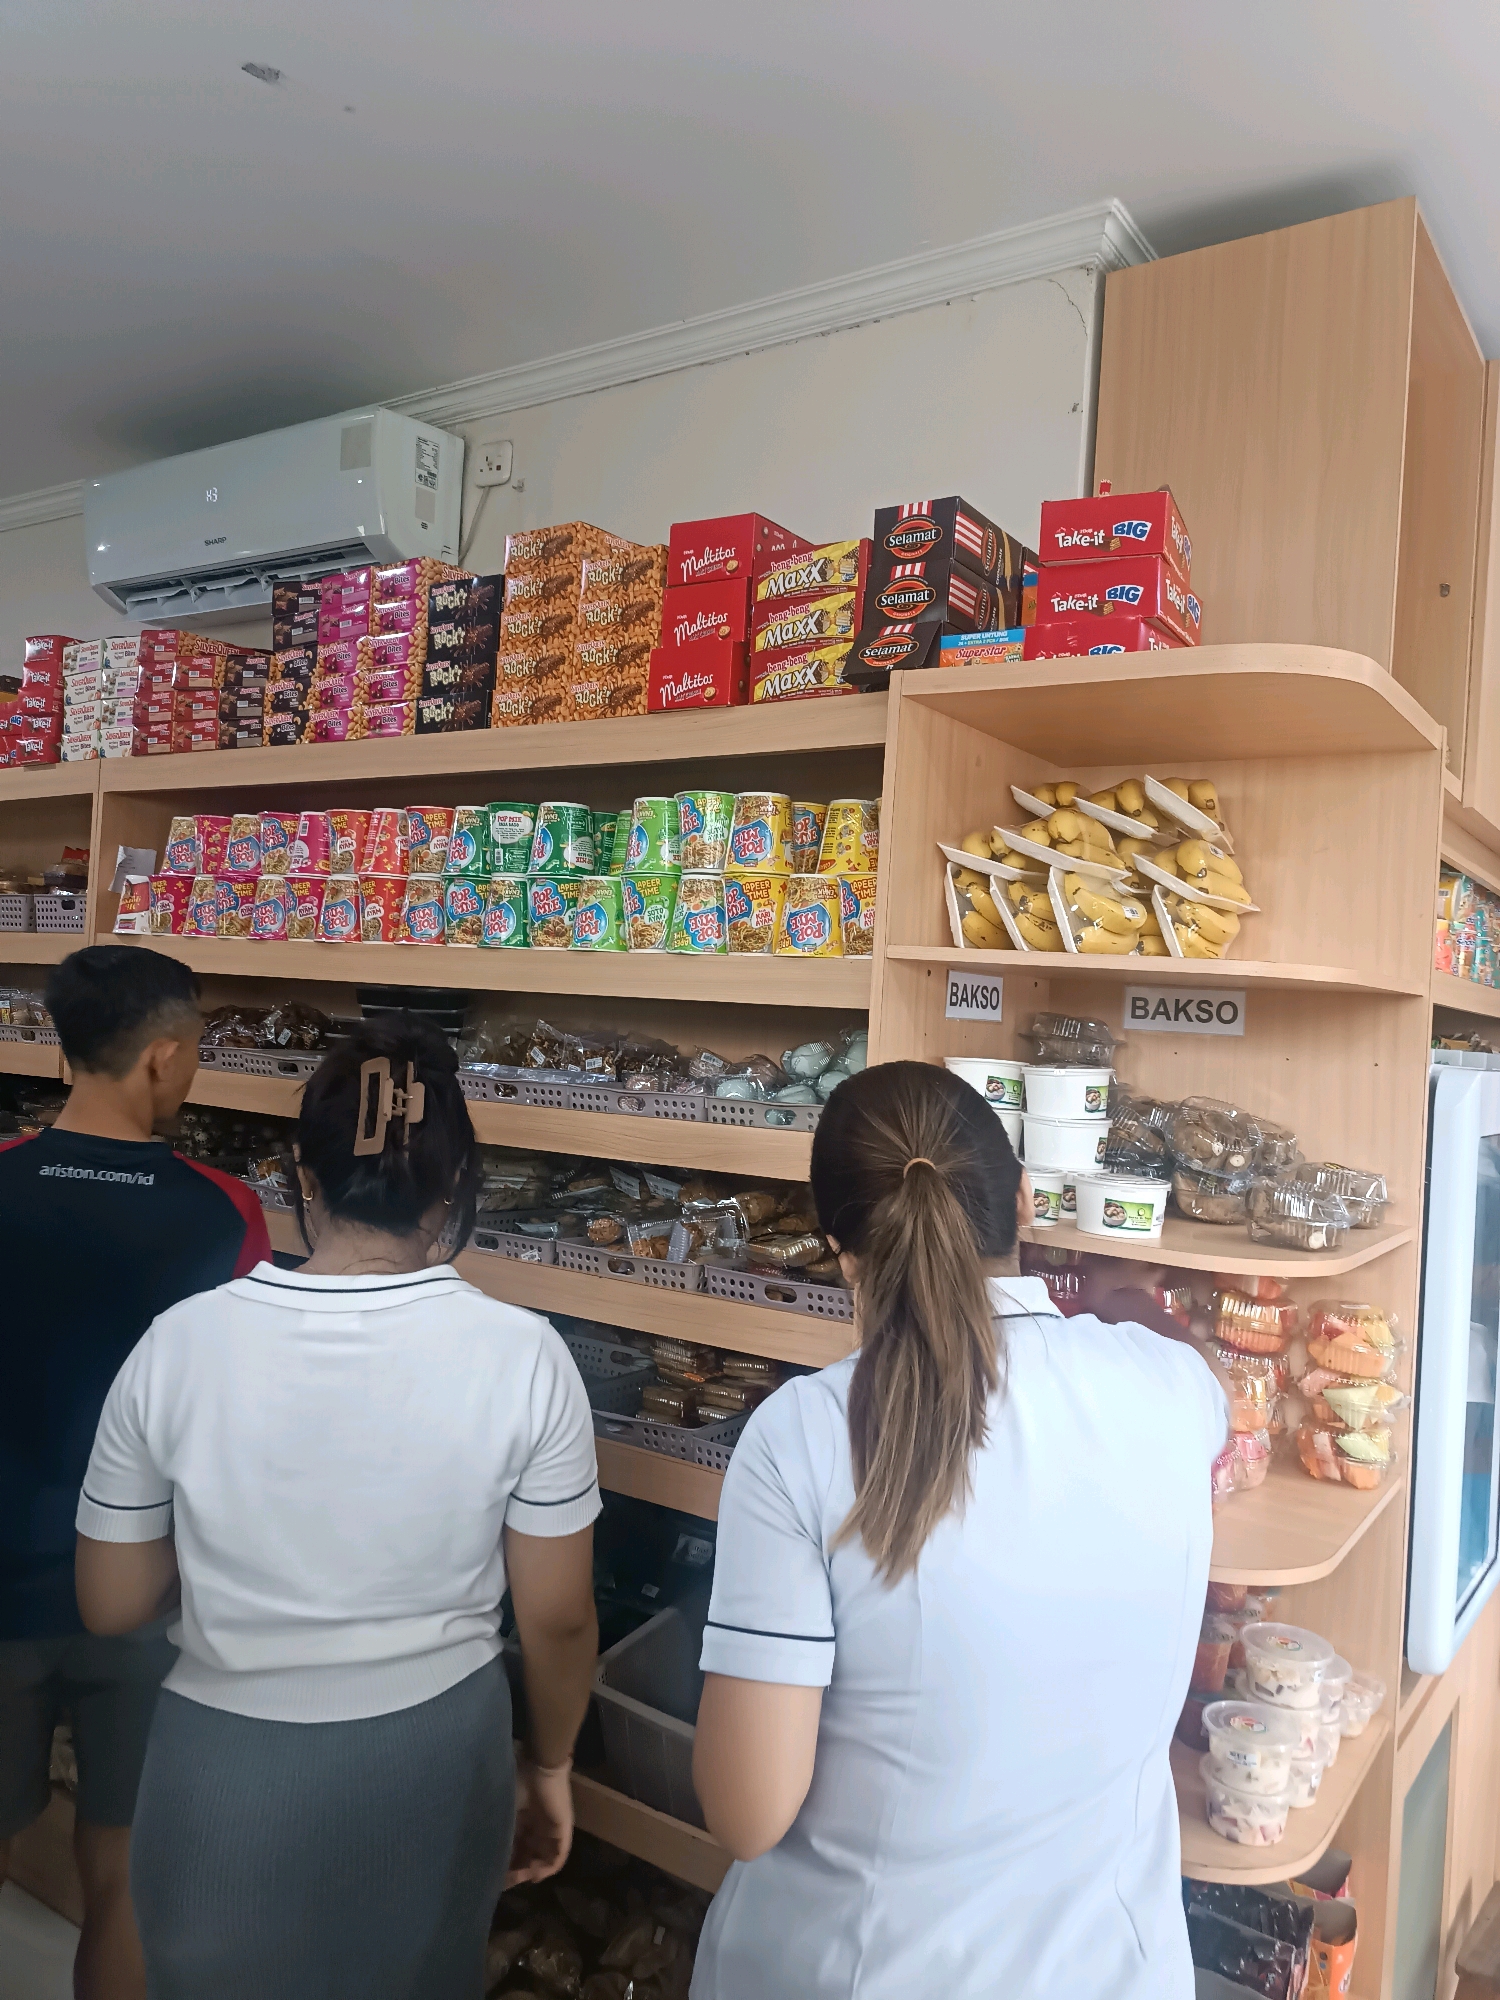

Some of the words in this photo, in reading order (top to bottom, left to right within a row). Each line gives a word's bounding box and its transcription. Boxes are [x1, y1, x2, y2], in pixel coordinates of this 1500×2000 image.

[889, 528, 938, 547] Selamat
[1055, 529, 1105, 548] Take-it
[1114, 522, 1149, 539] BIG
[204, 536, 227, 546] SHARP
[680, 546, 737, 583] Maltitos
[770, 550, 815, 574] beng-beng
[394, 575, 411, 586] Bites
[880, 589, 931, 607] Selamat
[1107, 586, 1141, 603] BIG
[1050, 593, 1099, 613] Take-it
[394, 610, 411, 620] Bites
[768, 602, 812, 625] beng-beng
[673, 610, 729, 647] Maltitos
[960, 632, 982, 641] SUPER
[981, 630, 1008, 640] UNTUNG
[336, 651, 352, 662] Bites
[386, 645, 403, 655] Bites
[863, 642, 914, 658] Selamat
[955, 645, 1008, 662] Superstar
[766, 653, 809, 675] beng-beng
[332, 686, 348, 696] Bites
[382, 679, 399, 690] Bites
[659, 671, 714, 708] Maltitos
[327, 719, 343, 729] Bites
[381, 714, 397, 725] Bites
[423, 812, 448, 823] LAPEER
[426, 820, 447, 829] TIME
[497, 815, 508, 823] POP
[734, 827, 760, 848] MIE
[739, 837, 766, 859] POP
[233, 882, 255, 893] LAPEER
[636, 877, 662, 890] LAPEER
[742, 879, 772, 893] LAPEER
[236, 889, 253, 898] TIME
[294, 888, 310, 897] TIME
[449, 887, 471, 906] POP
[532, 887, 553, 905] POP
[561, 891, 580, 900] TIME
[640, 886, 661, 898] TIME
[749, 888, 770, 900] TIME
[854, 888, 876, 899] TIME
[325, 904, 346, 919] MIE
[453, 900, 479, 916] MIE
[536, 898, 562, 917] MIE
[647, 907, 665, 917] SOTO
[328, 914, 350, 930] POP
[409, 908, 434, 924] MIE
[689, 912, 718, 933] MIE
[755, 911, 771, 921] KARI
[755, 918, 774, 927] AYAM
[789, 912, 819, 934] MIE
[415, 917, 439, 932] POP
[486, 919, 508, 936] POP
[576, 920, 600, 939] POP
[696, 924, 723, 942] POP
[796, 922, 825, 944] POP
[950, 983, 1000, 1011] BAKSO
[1130, 996, 1239, 1025] BAKSO
[39, 1163, 155, 1186] ariston.com/id
